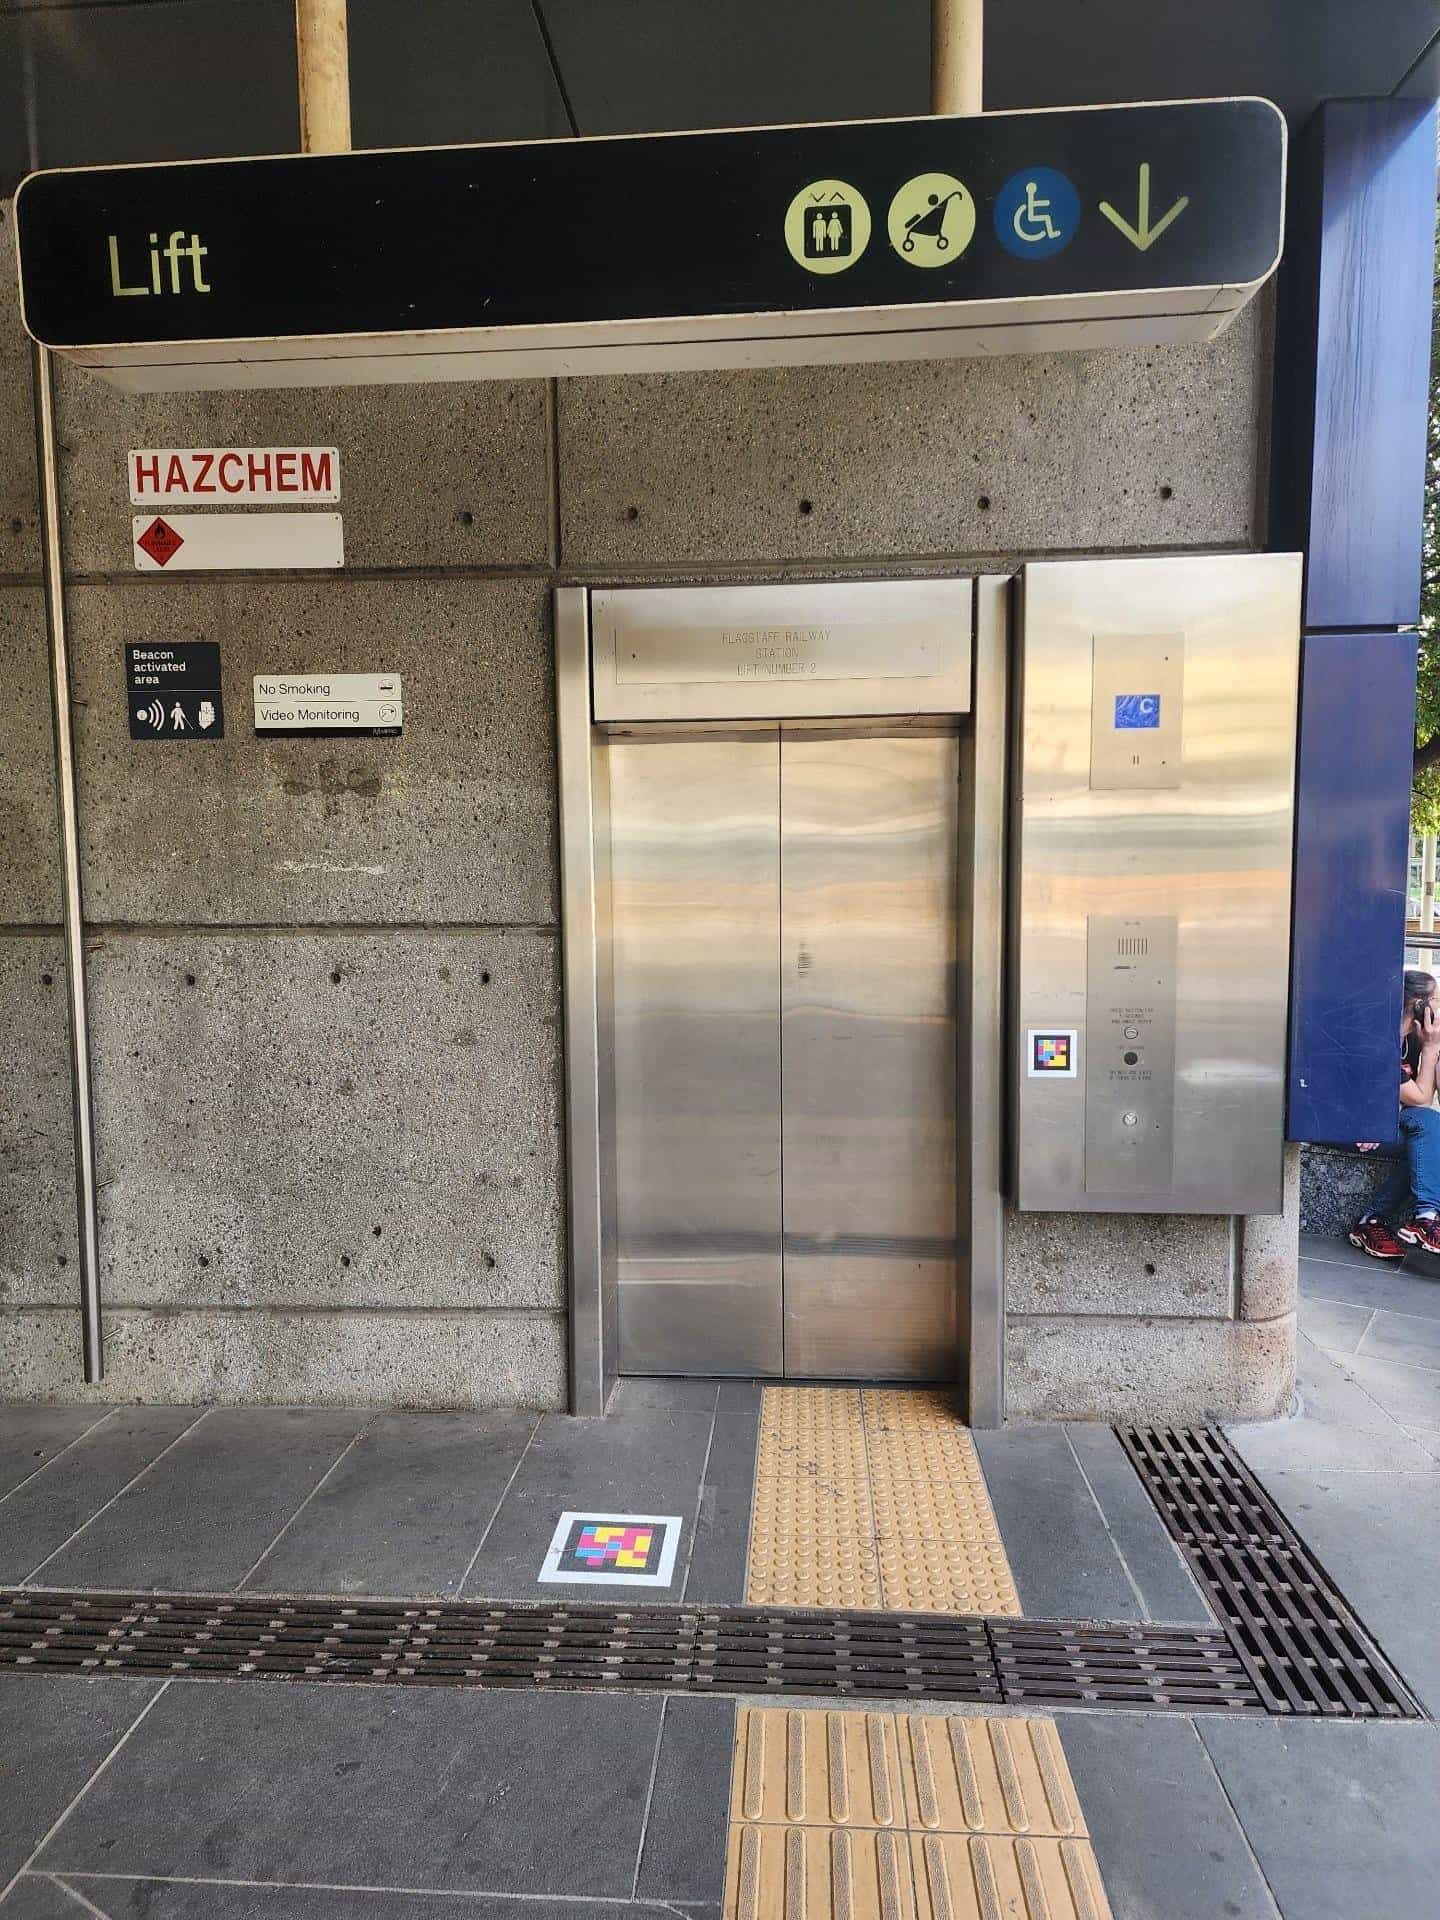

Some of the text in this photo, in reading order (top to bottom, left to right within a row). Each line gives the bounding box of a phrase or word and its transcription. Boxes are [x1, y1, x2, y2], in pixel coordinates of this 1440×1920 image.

[108, 230, 211, 297] Lift
[135, 453, 332, 493] HAZCHEM
[721, 629, 832, 644] FLAGSTAFF RAILWAY
[132, 649, 174, 660] Beacon
[755, 647, 799, 659] STATION
[133, 661, 187, 672] activated
[736, 662, 817, 676] LIFT NUMBER 2
[134, 676, 160, 685] area
[259, 682, 331, 697] No Smoking
[260, 708, 360, 723] Video Monitoring
